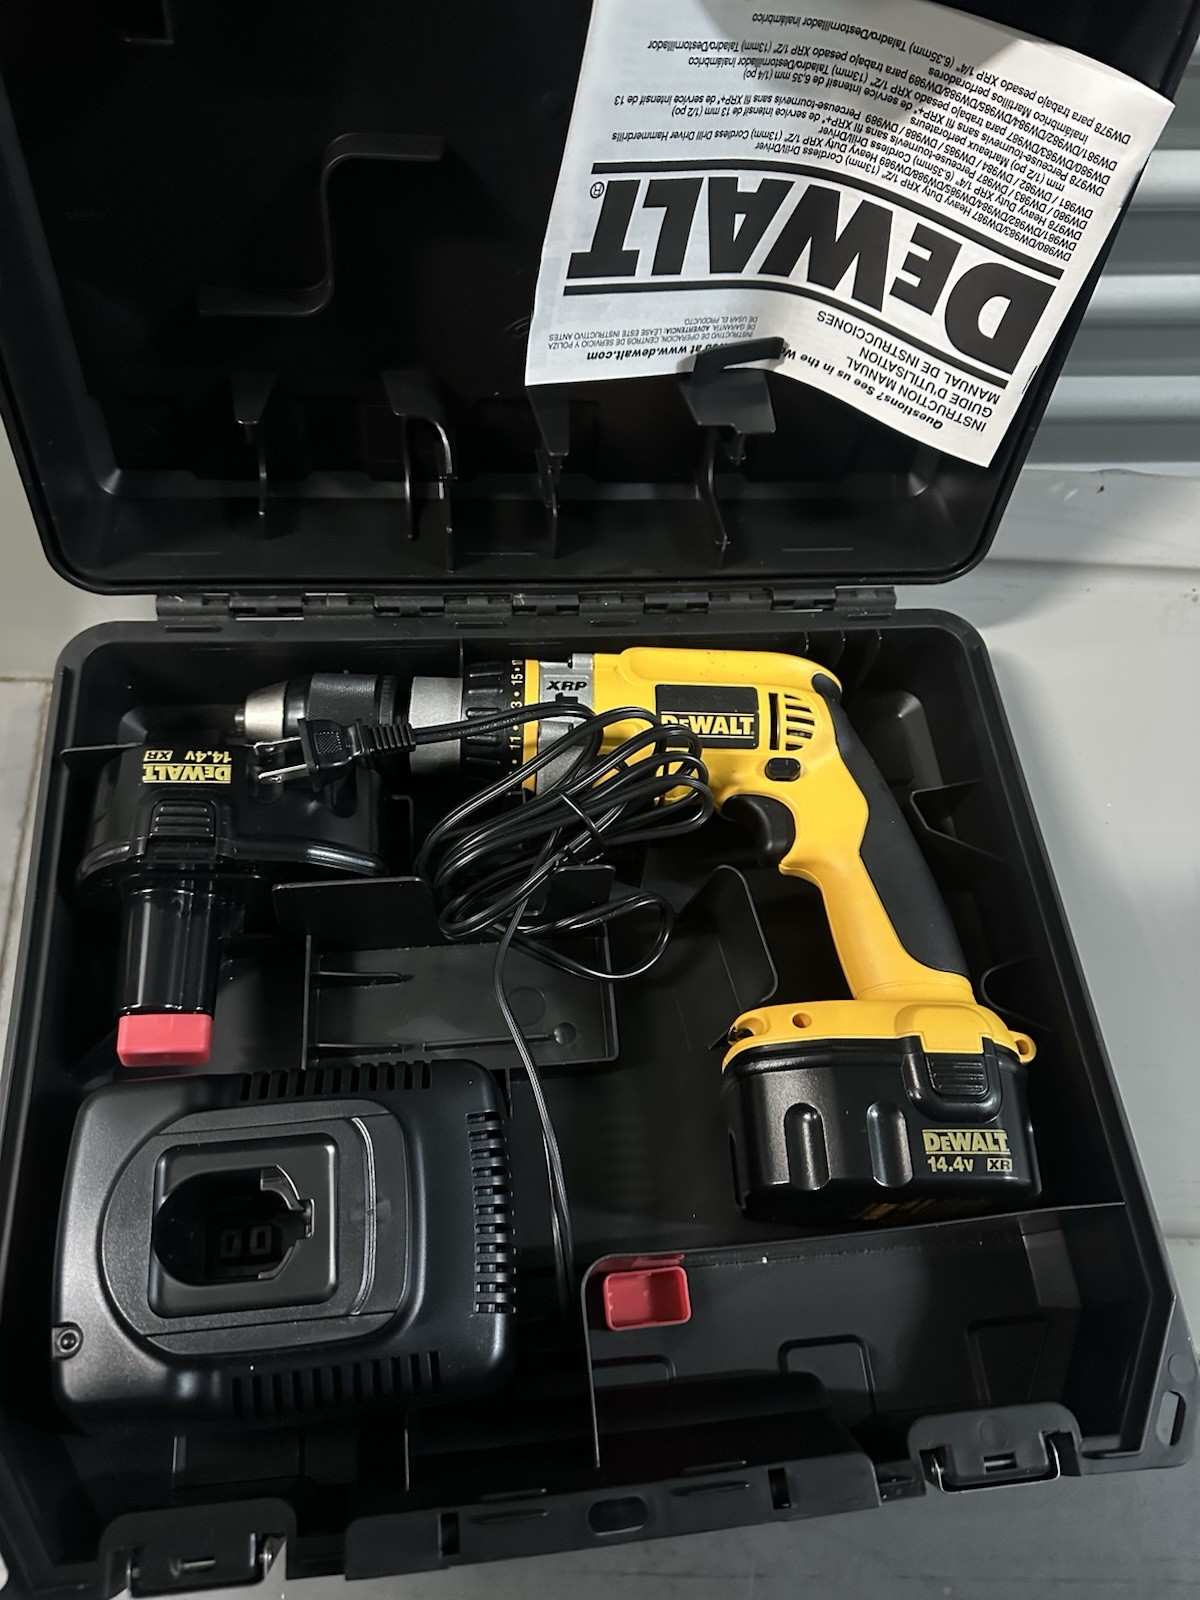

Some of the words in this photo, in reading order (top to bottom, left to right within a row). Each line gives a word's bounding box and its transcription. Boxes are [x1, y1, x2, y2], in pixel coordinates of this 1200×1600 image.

[752, 13, 802, 27] inalámbrico
[802, 17, 906, 53] Taladro/Destornillador
[647, 40, 739, 52] Taladro/Destornillador
[740, 39, 772, 53] (13mm)
[790, 45, 812, 57] XRP
[812, 47, 849, 61] pesado
[688, 56, 737, 68] inalámbrico
[848, 54, 884, 73] trabajo
[908, 43, 955, 69] (6.35mm)
[737, 57, 829, 76] Taladro/Destornillador
[743, 68, 758, 80] po)
[757, 68, 773, 81] (1/4
[885, 65, 909, 80] para
[774, 71, 791, 80] mm
[791, 72, 811, 84] 6,35
[812, 75, 825, 86] de
[831, 66, 869, 84] (13mm)
[927, 67, 991, 98] perforadores
[976, 71, 1000, 87] XRP
[825, 78, 862, 96] intensif
[889, 83, 913, 100] XRP
[1000, 79, 1037, 101] pesado
[614, 95, 624, 106] 13
[627, 95, 639, 105] de
[639, 95, 673, 106] intensif
[673, 95, 704, 105] service
[705, 95, 716, 104] de
[743, 95, 752, 105] fil
[753, 94, 773, 103] sans
[863, 87, 899, 105] service
[913, 91, 951, 112] pesado
[671, 105, 687, 117] po)
[686, 105, 703, 117] (1/2
[704, 107, 721, 115] mm
[721, 107, 730, 116] 13
[732, 106, 743, 116] de
[742, 106, 774, 117] intensif
[774, 95, 862, 121] Perceuse-tournevis
[775, 107, 807, 119] service
[900, 100, 913, 111] de
[990, 92, 1032, 119] Martillos
[1037, 95, 1071, 118] trabajo
[808, 112, 821, 123] de
[864, 114, 899, 133] DW989
[945, 117, 956, 129] fil
[950, 106, 984, 127] trabajo
[1071, 111, 1095, 128] para
[669, 131, 696, 139] Driver
[695, 130, 713, 139] Drill
[714, 129, 749, 140] Cordless
[750, 128, 783, 142] (13mm)
[853, 122, 864, 134] fil
[865, 126, 889, 140] sans
[910, 116, 968, 146] perforateurs
[956, 122, 980, 138] sans
[985, 120, 1008, 136] para
[1033, 111, 1089, 145] inalámbrico
[1094, 122, 1131, 145] DW978
[611, 131, 669, 142] Hammerdrills
[802, 136, 824, 148] XRP
[818, 126, 869, 148] Drill/Driver
[904, 128, 938, 149] DW988
[754, 142, 801, 155] Drill/Driver
[824, 139, 848, 153] Duty
[848, 145, 879, 163] Heavy
[870, 140, 911, 163] Cordless
[967, 140, 1010, 168] Marteaux
[802, 147, 844, 164] Cordless
[889, 135, 977, 179] Perceuse-tournevis
[943, 144, 977, 166] DW985
[980, 133, 1069, 182] Perceuse-tournevis
[1005, 132, 1111, 186] DW980/DW983/DW987
[845, 155, 881, 176] (13mm)
[912, 155, 955, 182] (6.35mm)
[981, 161, 1014, 184] DW984
[1010, 159, 1028, 174] po)
[976, 173, 1009, 196] DW987
[1026, 169, 1046, 185] (1/2
[1046, 178, 1065, 192] mm
[900, 178, 921, 193] XRP
[1019, 179, 1053, 202] DW982
[1069, 175, 1105, 197] DW978
[921, 185, 944, 203] Duty
[973, 186, 995, 202] XRP
[1014, 191, 1048, 213] DW983
[943, 195, 972, 217] Heavy
[994, 194, 1017, 213] Duty
[1058, 198, 1094, 219] DW981
[1017, 205, 1048, 227] Heavy
[1052, 209, 1088, 230] DW980
[971, 211, 1072, 262] DW980/DW983/DW987
[1047, 220, 1083, 241] DW978
[817, 310, 920, 368] INSTRUCCIONES
[587, 345, 687, 362] www.dewalt.com
[800, 354, 820, 368] the
[823, 363, 835, 375] in
[837, 370, 852, 381] us
[846, 356, 897, 391] MANUAL
[859, 346, 948, 400] D'UTILISATION
[920, 361, 941, 379] DE
[853, 378, 876, 396] See
[944, 371, 1001, 405] MANUAL
[876, 392, 943, 430] Questions?
[898, 384, 987, 433] INSTRUCTION
[949, 392, 993, 418] GUIDE
[510, 673, 523, 686] 15
[546, 680, 588, 691] XRP
[510, 736, 521, 750] 11
[146, 751, 171, 761] XR
[988, 1158, 1012, 1171] XR
